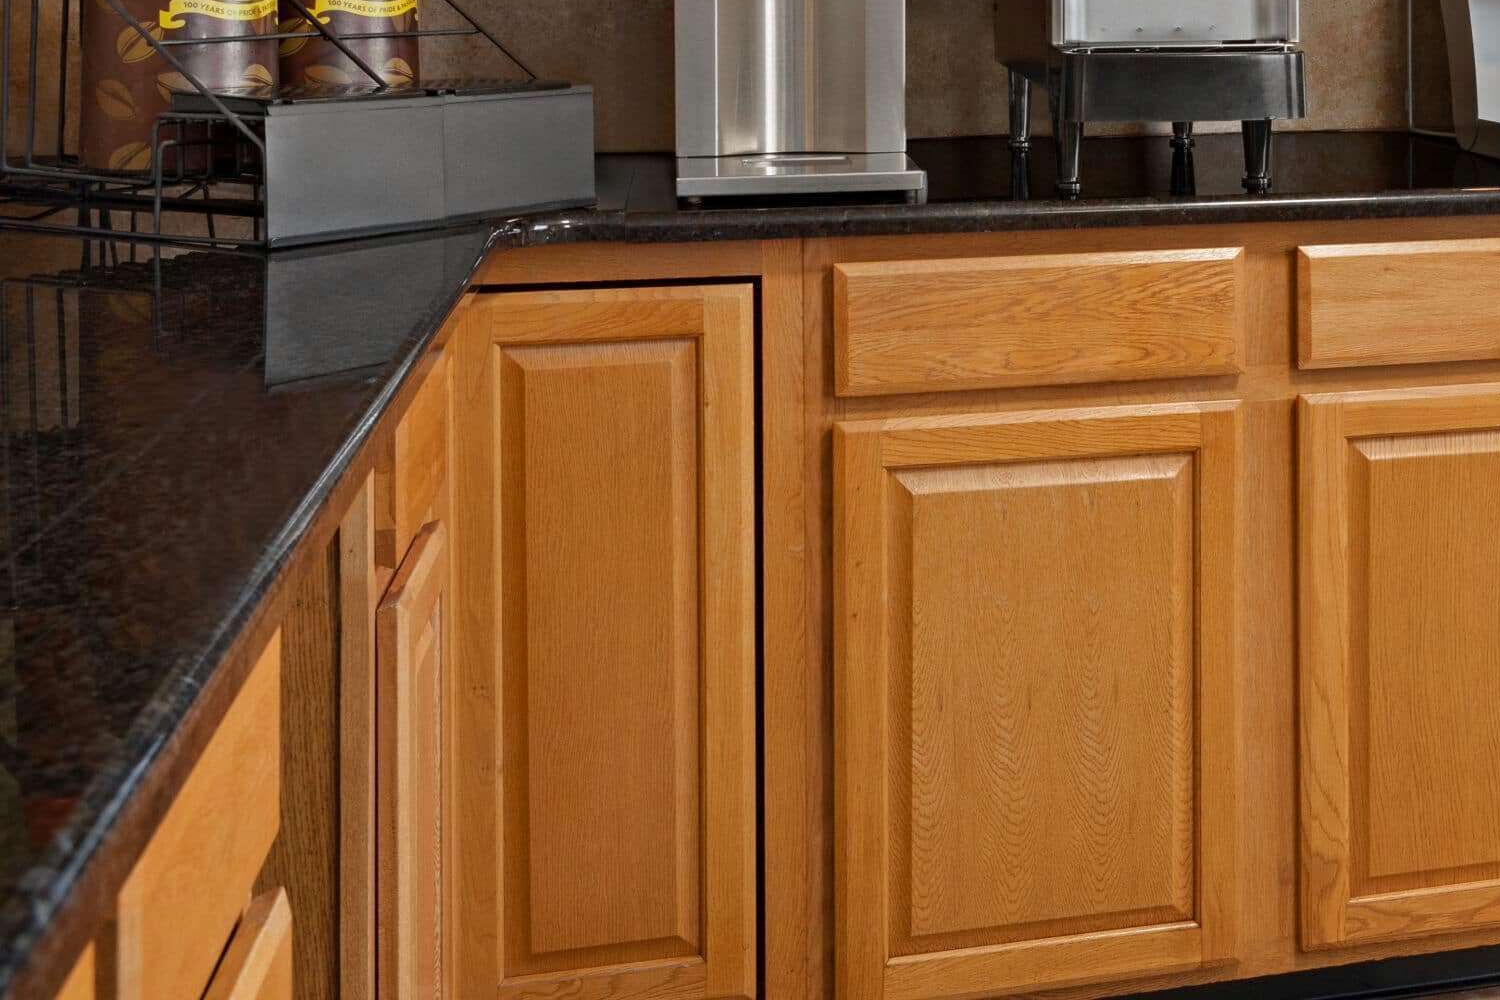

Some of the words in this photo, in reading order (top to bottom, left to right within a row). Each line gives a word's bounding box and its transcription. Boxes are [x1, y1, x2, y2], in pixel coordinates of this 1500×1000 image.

[183, 1, 199, 9] 100
[200, 2, 226, 15] YEARS
[343, 1, 367, 12] YEARS
